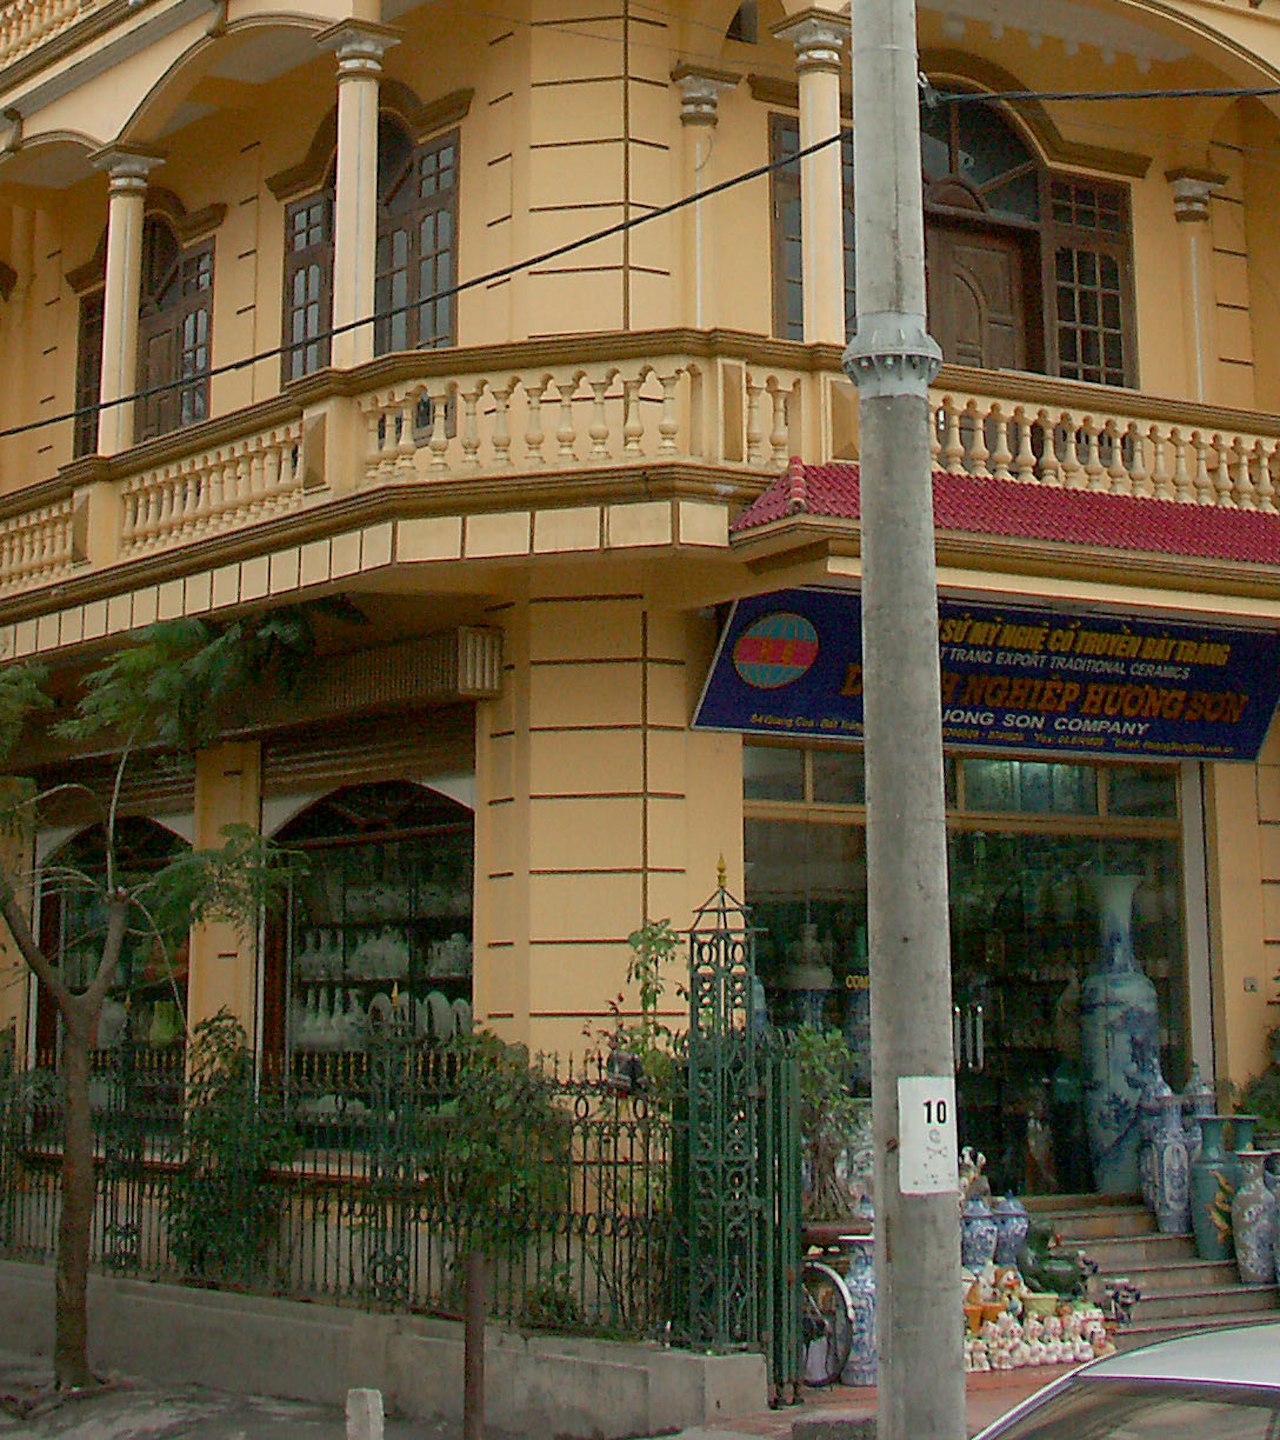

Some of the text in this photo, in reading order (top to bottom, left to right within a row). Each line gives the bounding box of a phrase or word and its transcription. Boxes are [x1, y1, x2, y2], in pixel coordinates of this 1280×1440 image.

[948, 647, 994, 665] TRANG
[996, 653, 1048, 669] EXPORT
[1050, 657, 1126, 676] TRADITIONAL
[1130, 664, 1191, 680] CERAMICS
[1003, 713, 1046, 730] SON
[1054, 717, 1151, 736] COMPANY
[923, 1100, 946, 1124] 10
